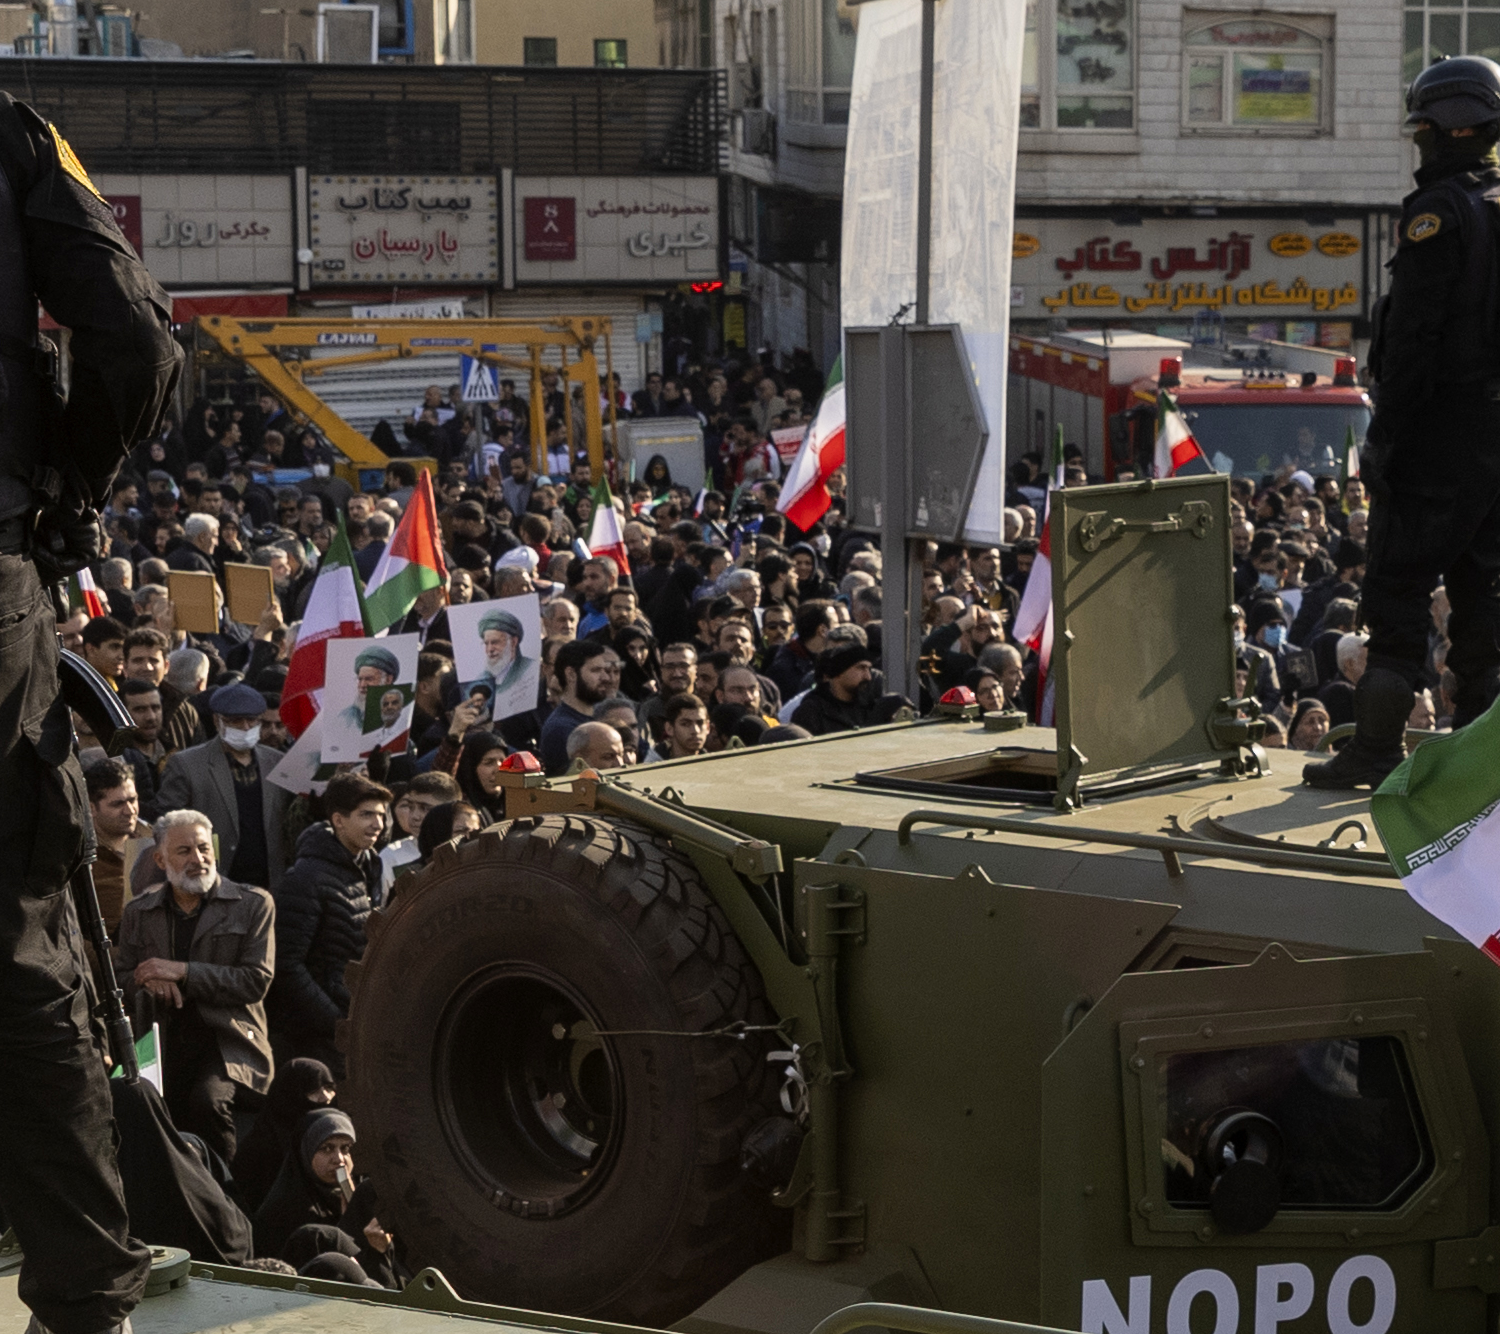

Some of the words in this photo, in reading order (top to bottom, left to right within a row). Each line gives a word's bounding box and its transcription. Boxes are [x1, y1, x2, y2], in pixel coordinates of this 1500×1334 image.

[338, 188, 412, 222] کتاب
[544, 204, 559, 218] 8
[642, 201, 711, 218] محصولات
[156, 213, 217, 248] روز
[543, 219, 559, 233] ۸
[354, 229, 459, 262] پارسیان
[1055, 235, 1143, 280] کتاب
[1151, 231, 1255, 280] آژانس
[1043, 282, 1121, 313] کتاب
[1126, 282, 1233, 312] اینترنتی
[1238, 276, 1358, 311] فروشگاه
